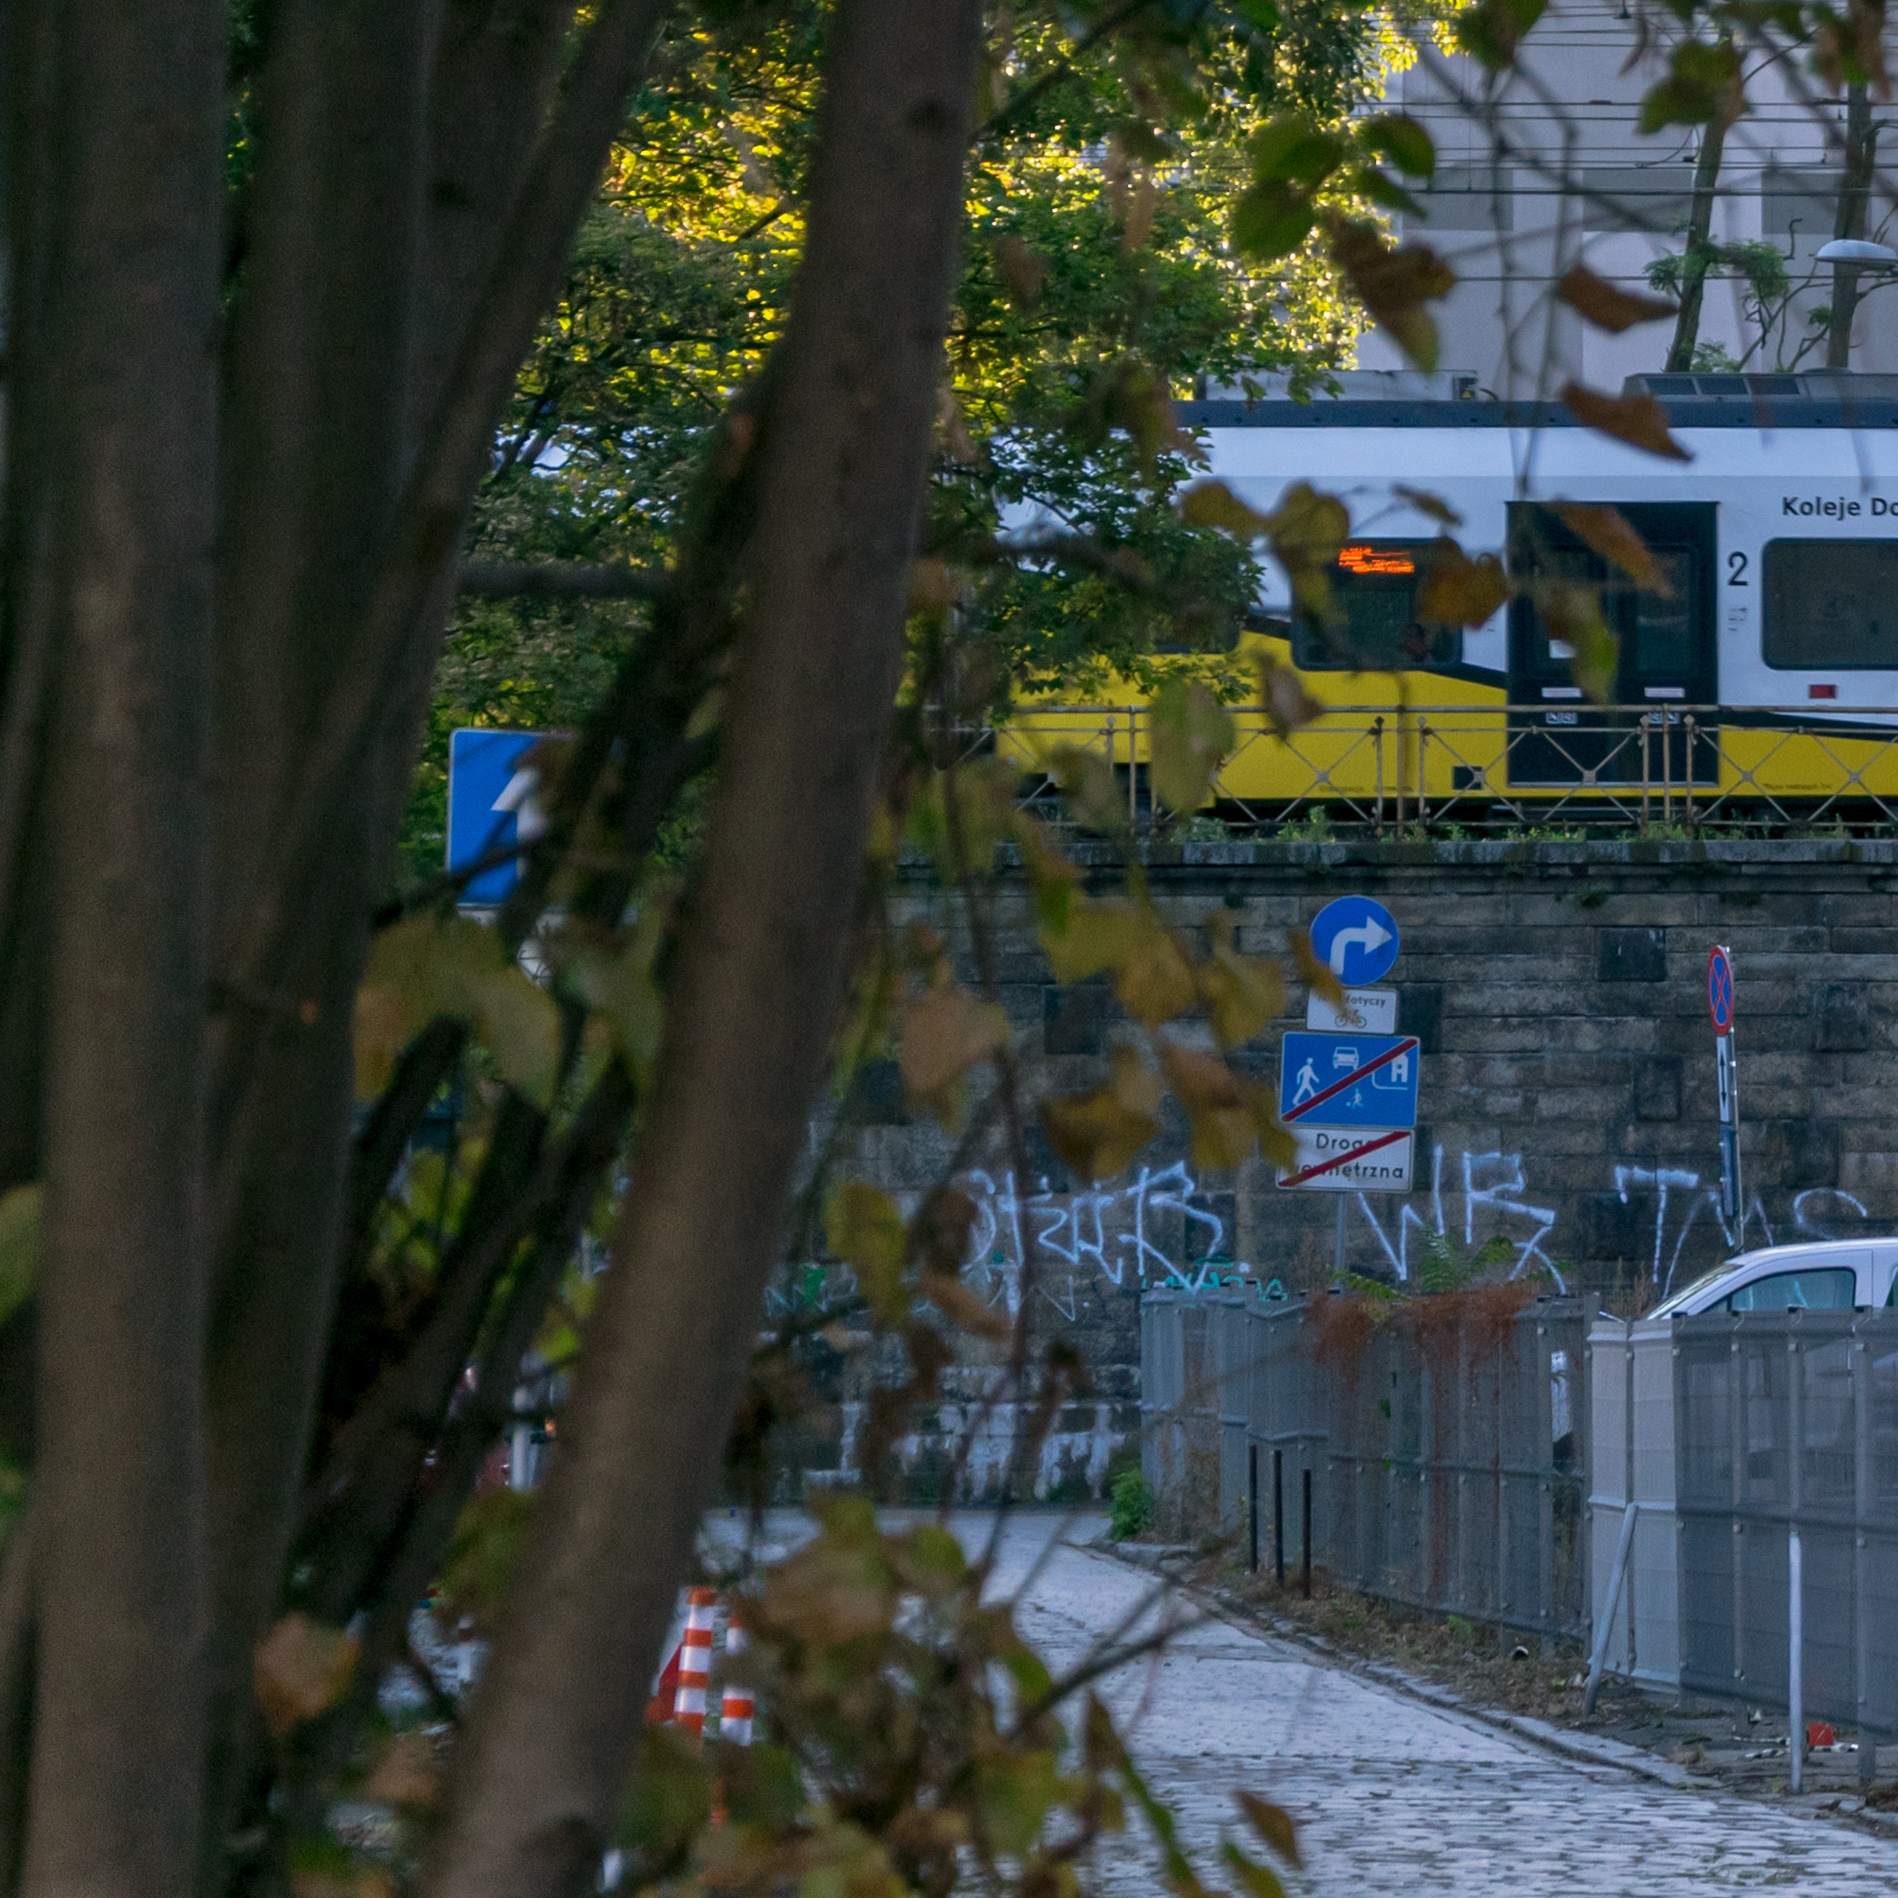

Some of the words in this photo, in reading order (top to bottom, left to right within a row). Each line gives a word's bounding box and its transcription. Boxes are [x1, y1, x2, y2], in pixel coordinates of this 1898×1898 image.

[1781, 496, 1861, 521] Koleje
[1727, 551, 1748, 586] 2
[1316, 1132, 1377, 1152] Drog
